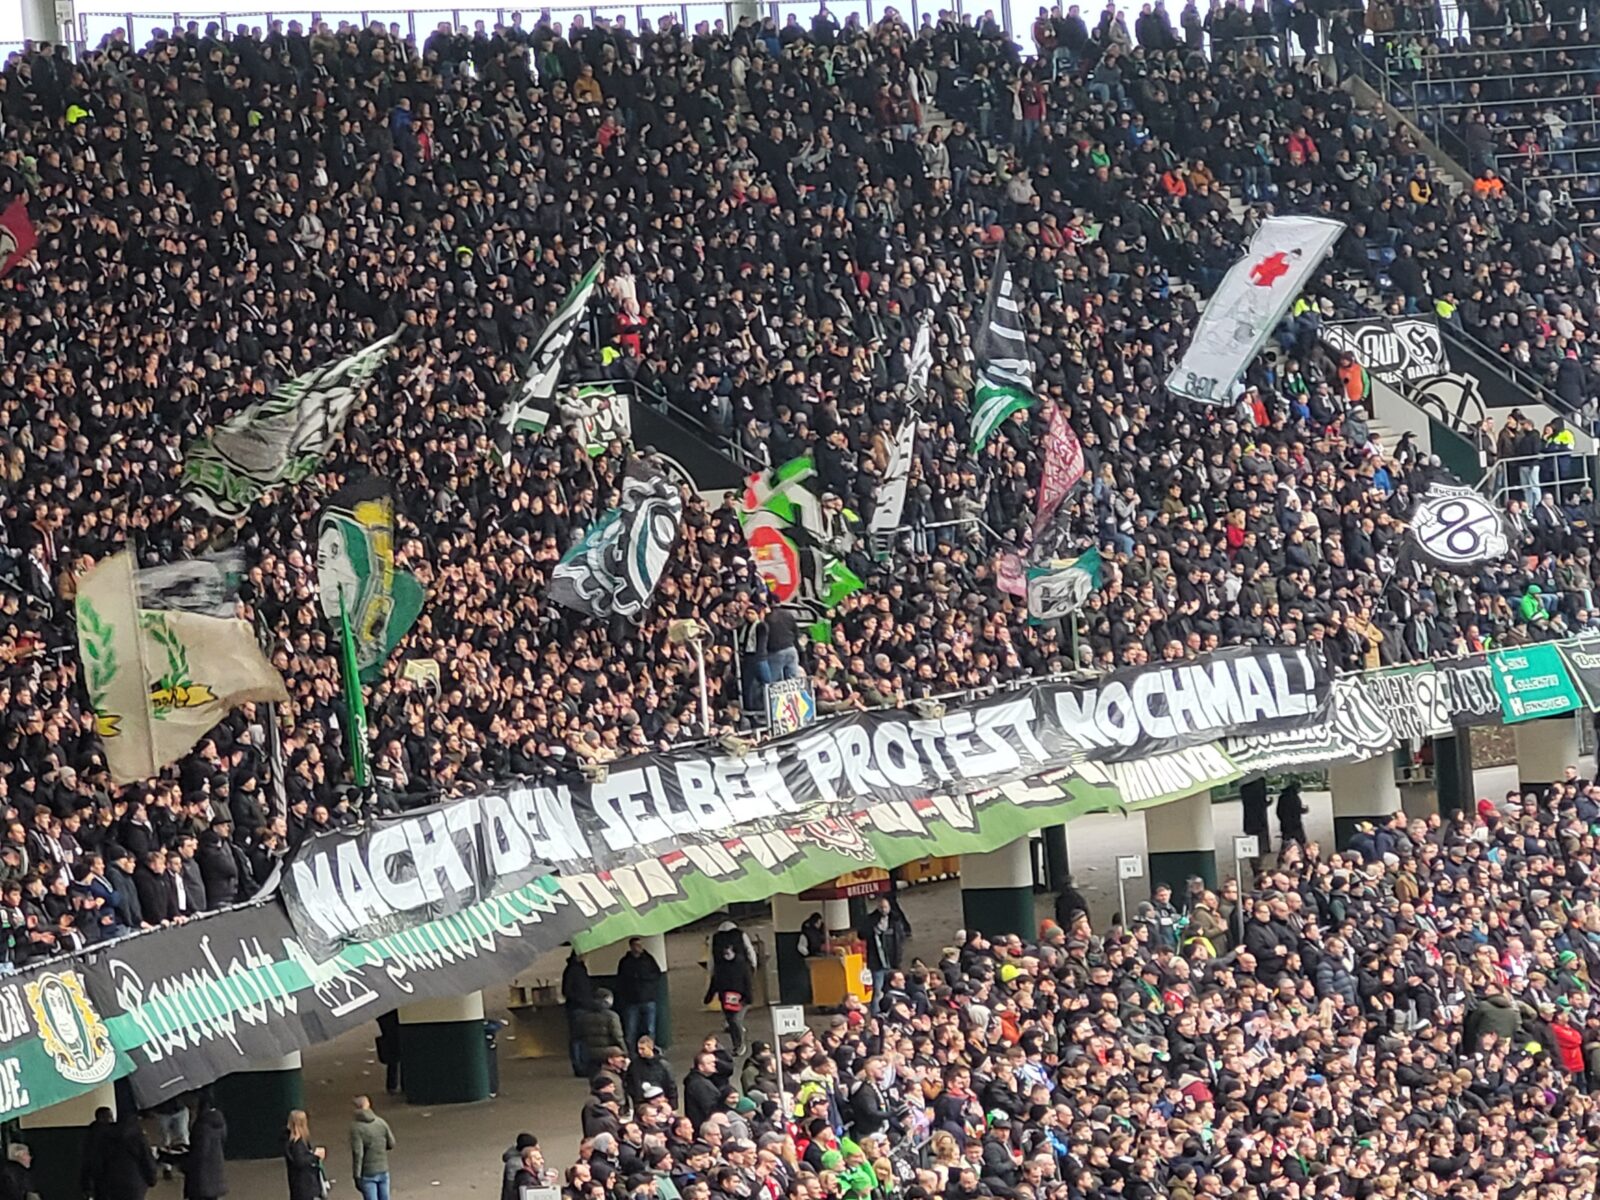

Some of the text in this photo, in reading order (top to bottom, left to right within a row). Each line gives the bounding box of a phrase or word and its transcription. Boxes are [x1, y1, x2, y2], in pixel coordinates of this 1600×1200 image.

[292, 798, 482, 939] MACHT
[484, 785, 592, 876] DEN
[591, 750, 799, 851] SELBEN
[797, 698, 1051, 800] PROTEST
[1055, 650, 1317, 749] NOCHMAL!
[847, 882, 880, 897] BREZELN
